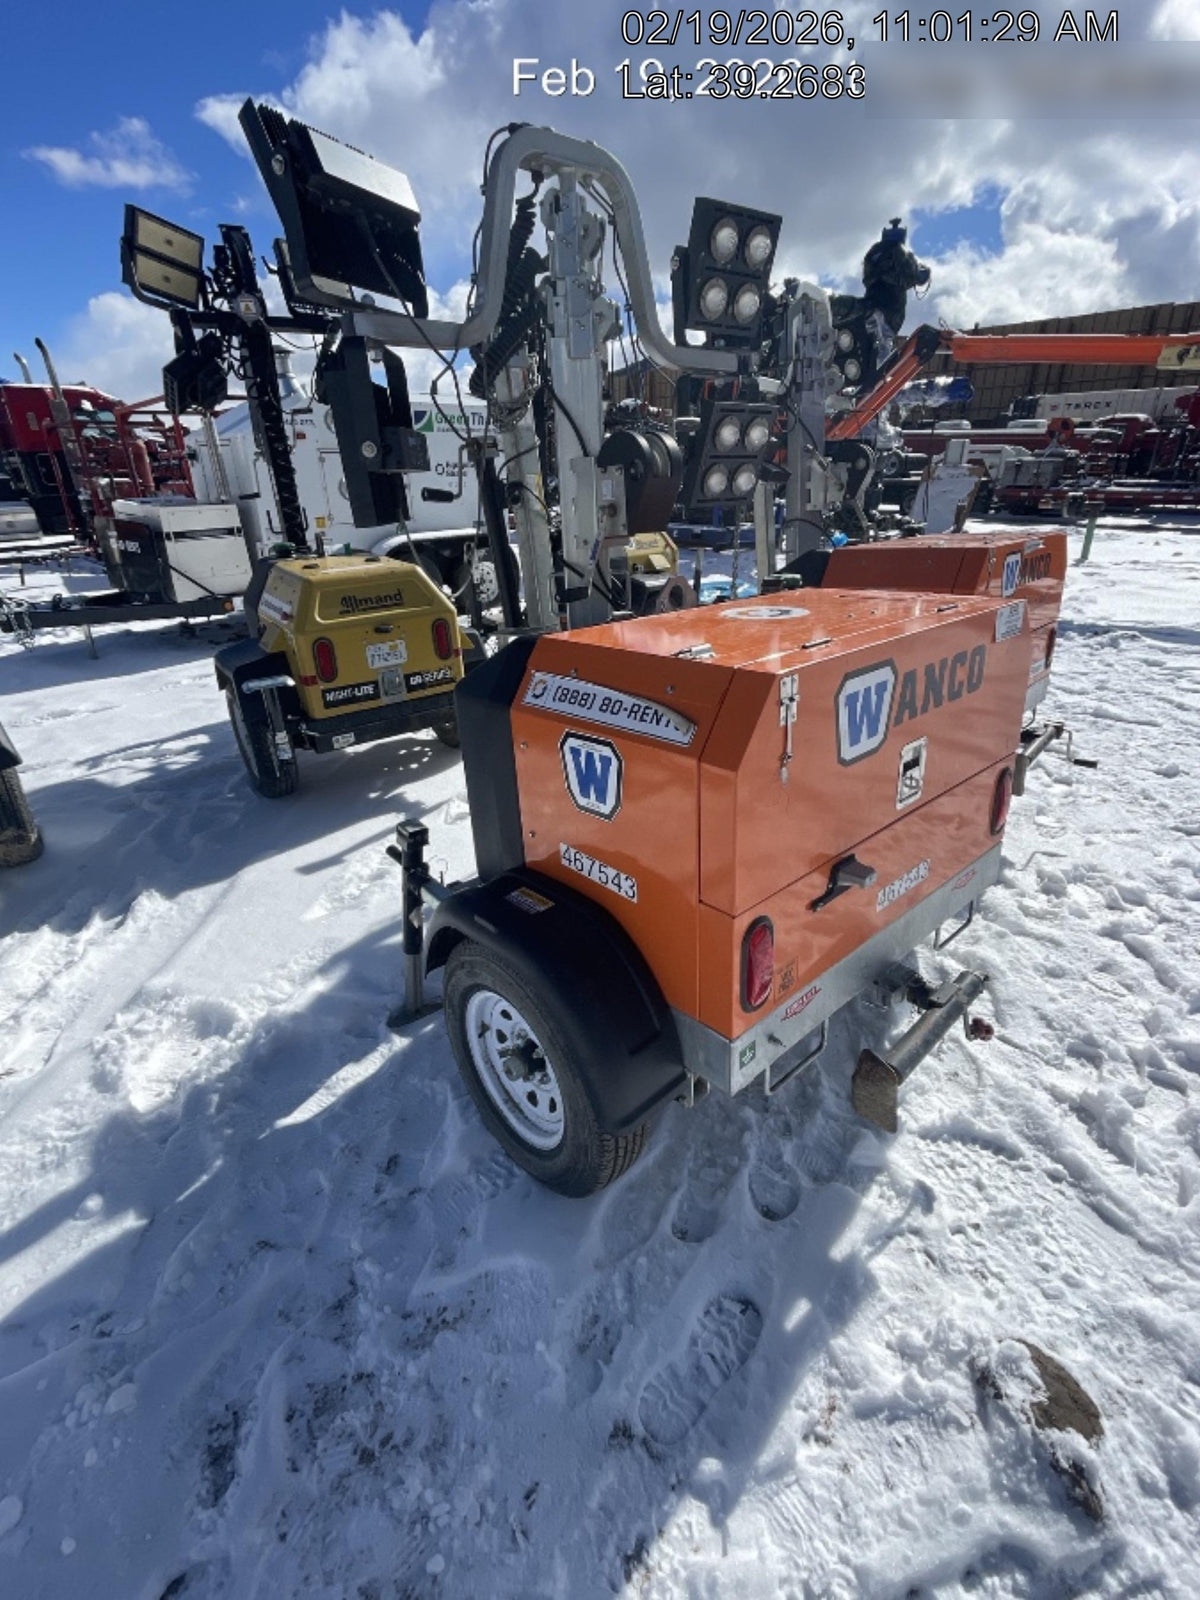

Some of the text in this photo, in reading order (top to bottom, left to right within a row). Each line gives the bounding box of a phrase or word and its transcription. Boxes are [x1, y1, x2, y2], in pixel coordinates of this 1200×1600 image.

[340, 590, 404, 613] Allmand
[552, 685, 597, 709] (888)
[570, 746, 612, 805] W
[562, 847, 636, 899] 467543
